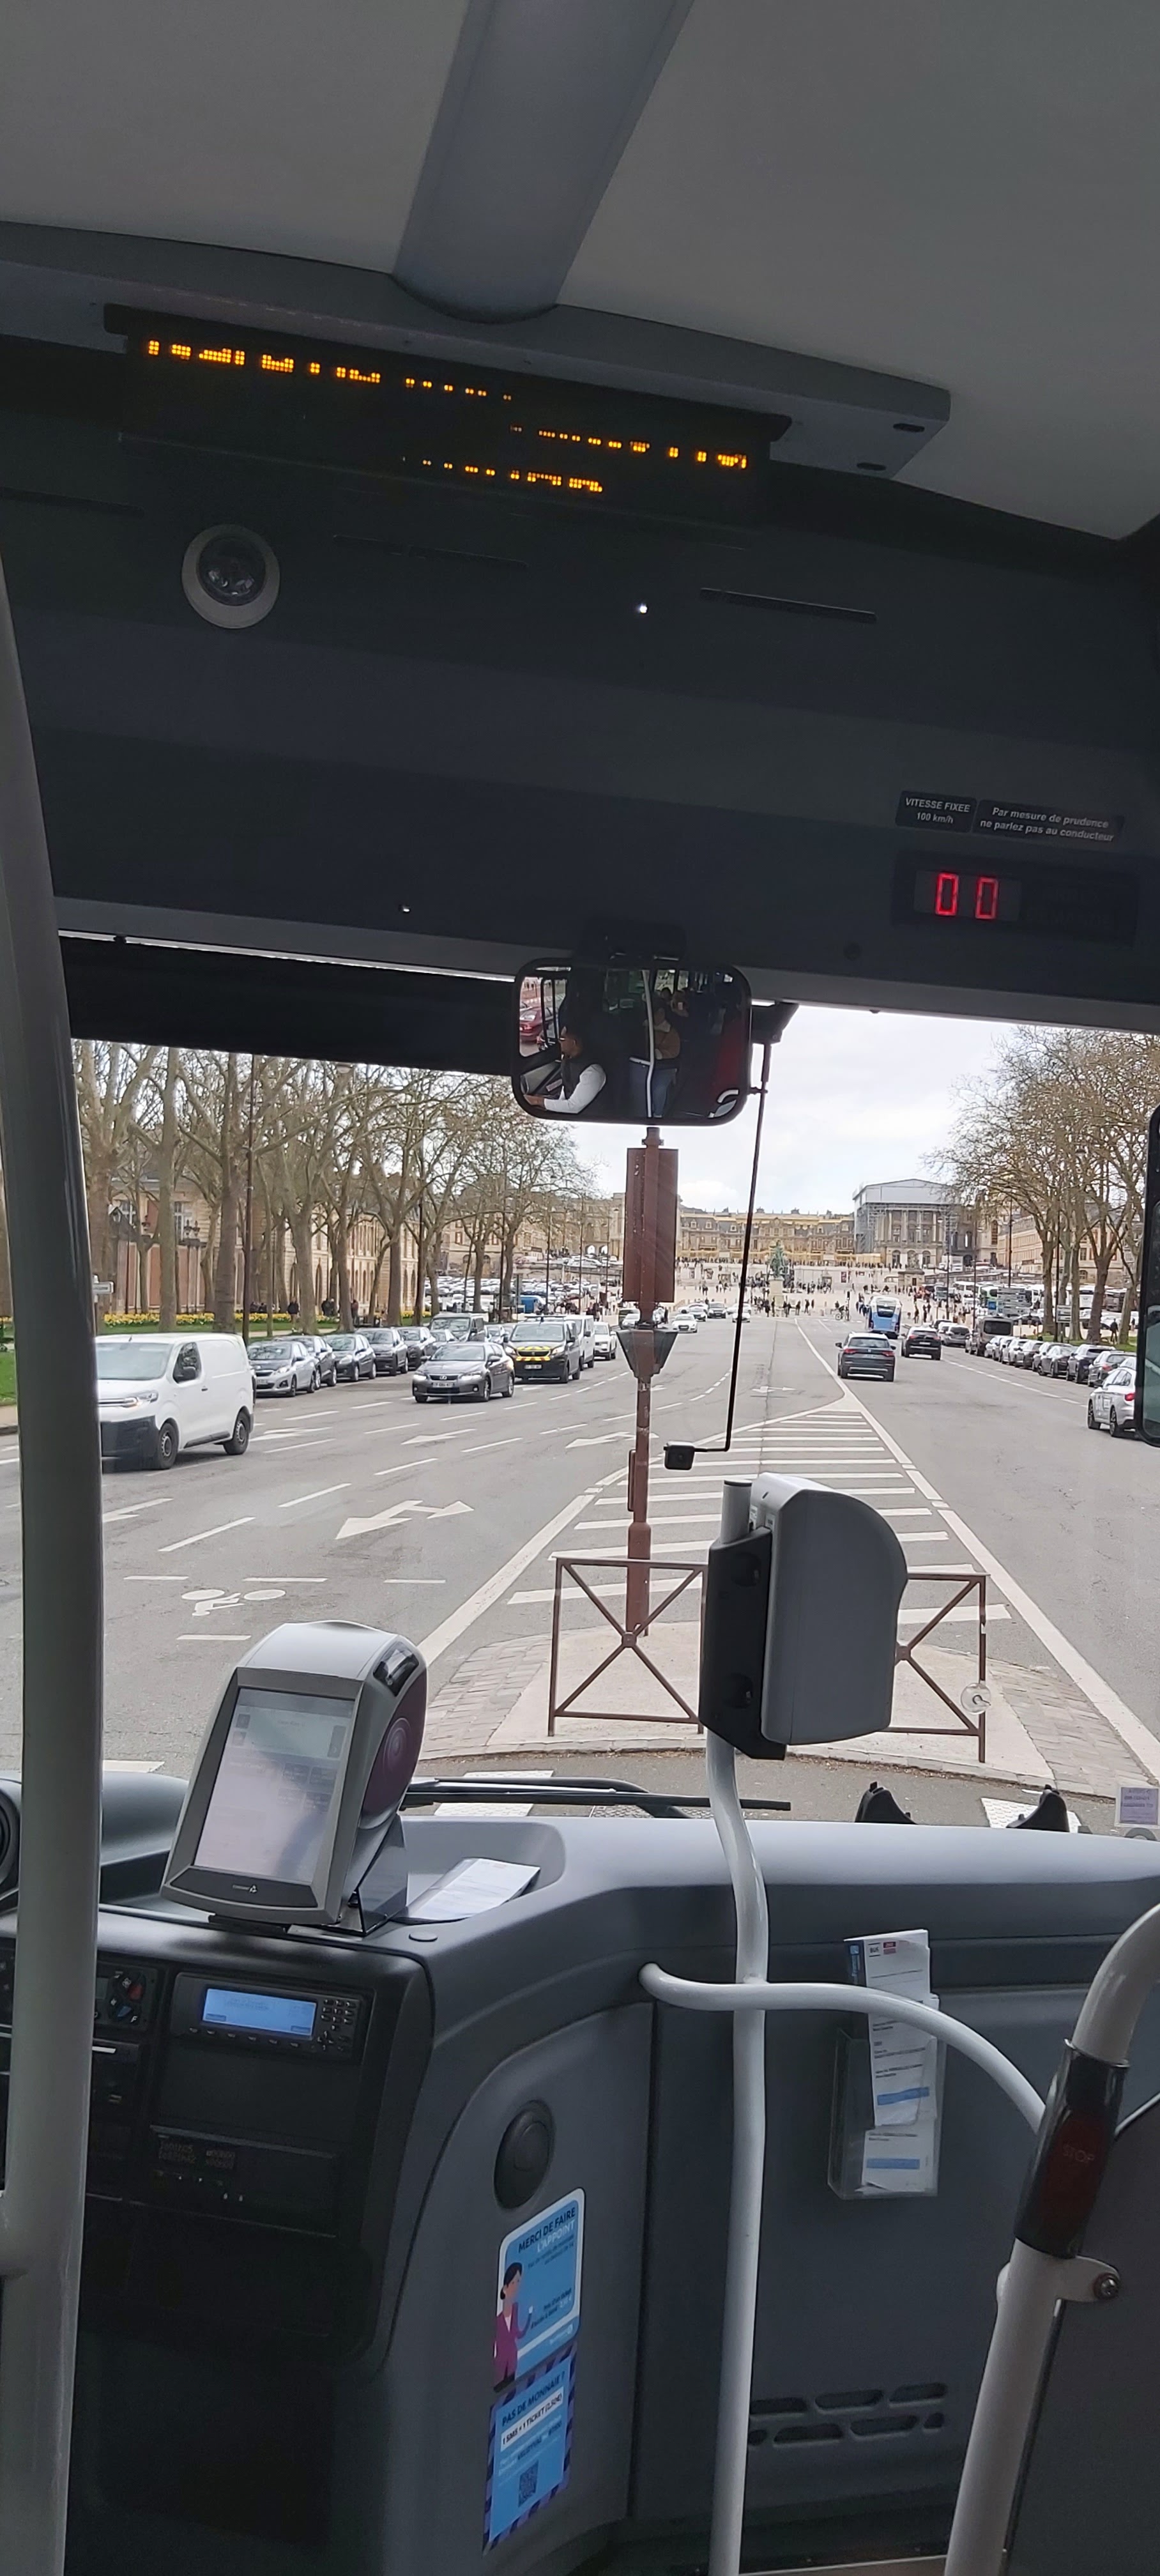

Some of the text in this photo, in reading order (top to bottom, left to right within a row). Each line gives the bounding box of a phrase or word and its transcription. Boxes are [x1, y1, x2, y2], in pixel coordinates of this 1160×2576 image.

[905, 797, 971, 813] VITESSE FIXEE
[916, 811, 954, 824] 100 km/h
[991, 807, 1110, 829] Par mesure de prudence
[980, 820, 1115, 843] ne parlez pas au conducteur
[1062, 2143, 1094, 2164] STOP
[518, 2228, 542, 2253] MERCI
[543, 2221, 553, 2236] DE
[555, 2207, 575, 2228] FAIRE
[537, 2220, 575, 2253] L'APPOINT
[502, 2409, 516, 2427] PAS
[517, 2400, 526, 2415] DE
[528, 2374, 560, 2407] MONNAIE
